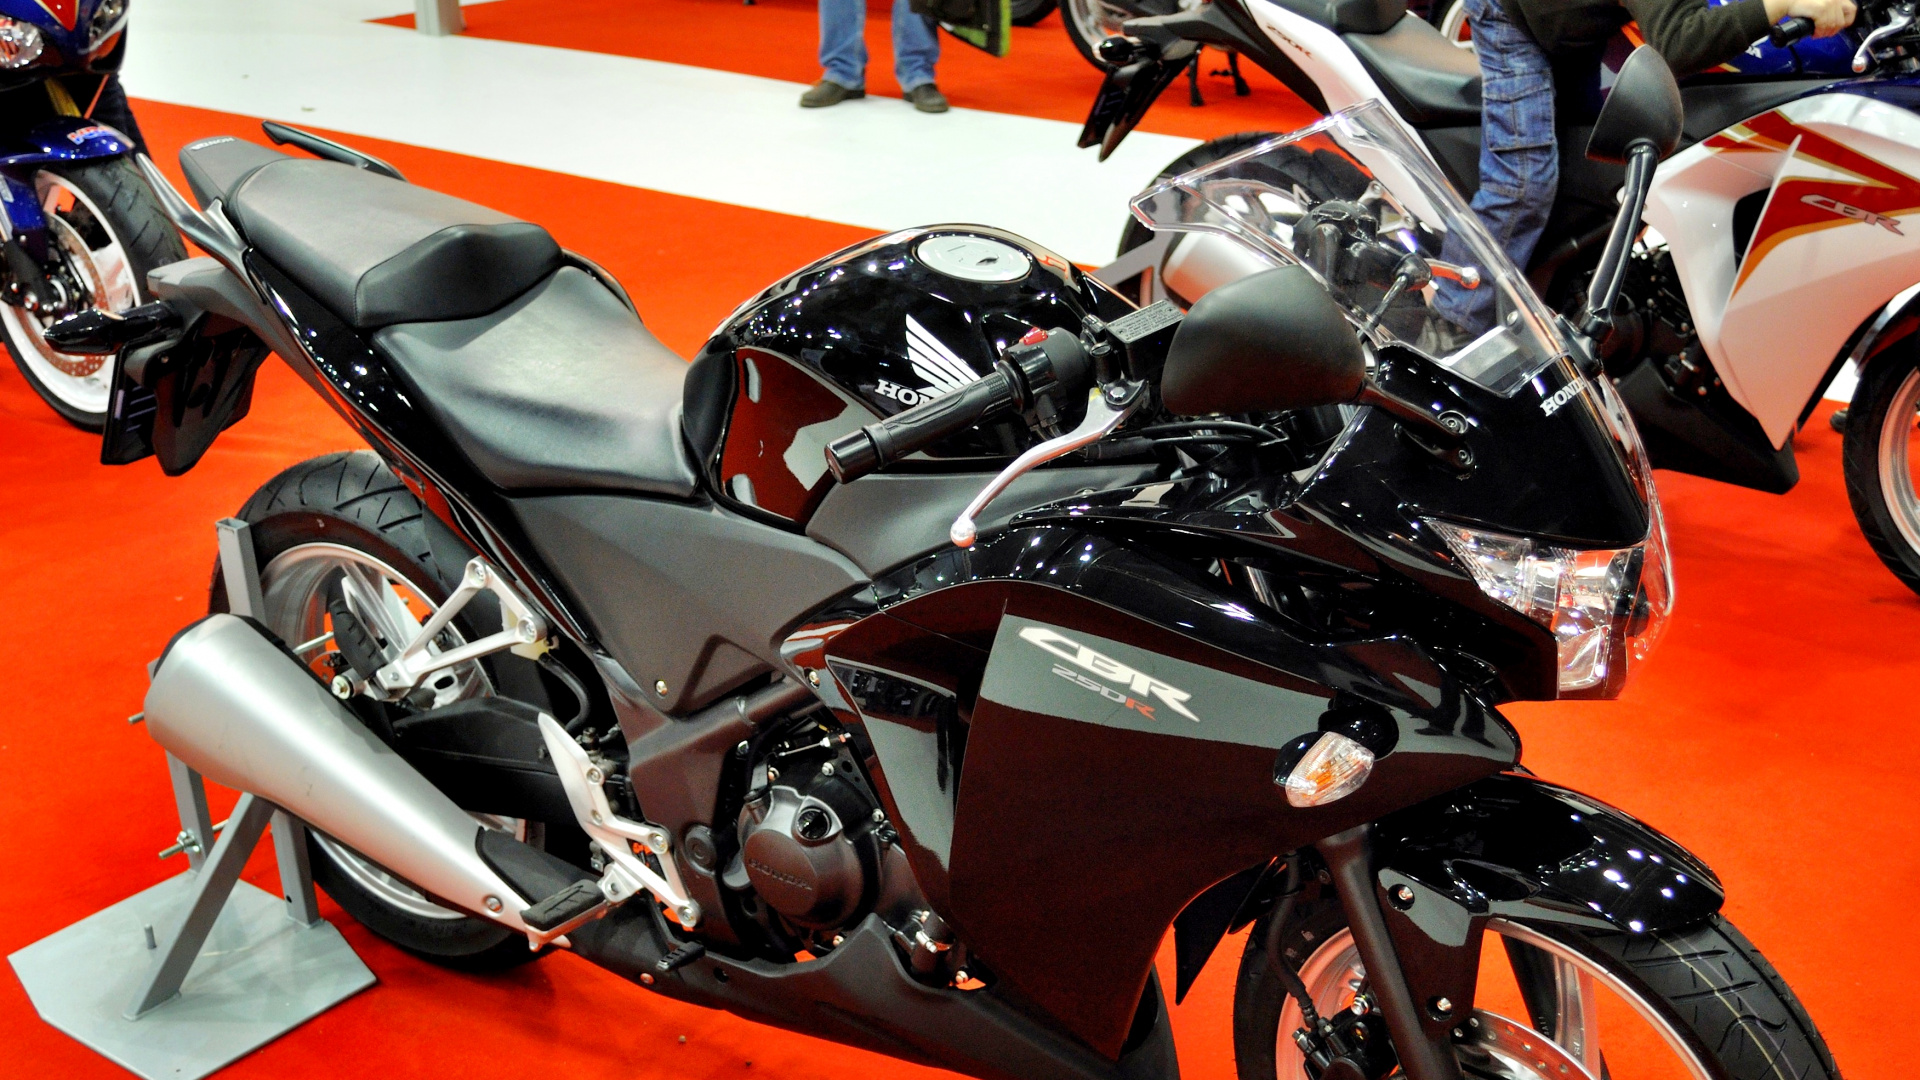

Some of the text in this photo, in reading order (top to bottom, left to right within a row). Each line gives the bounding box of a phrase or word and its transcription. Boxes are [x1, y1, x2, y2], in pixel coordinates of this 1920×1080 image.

[1800, 194, 1905, 236] CBR
[1018, 626, 1201, 723] CBR
[1052, 663, 1157, 722] 250R
